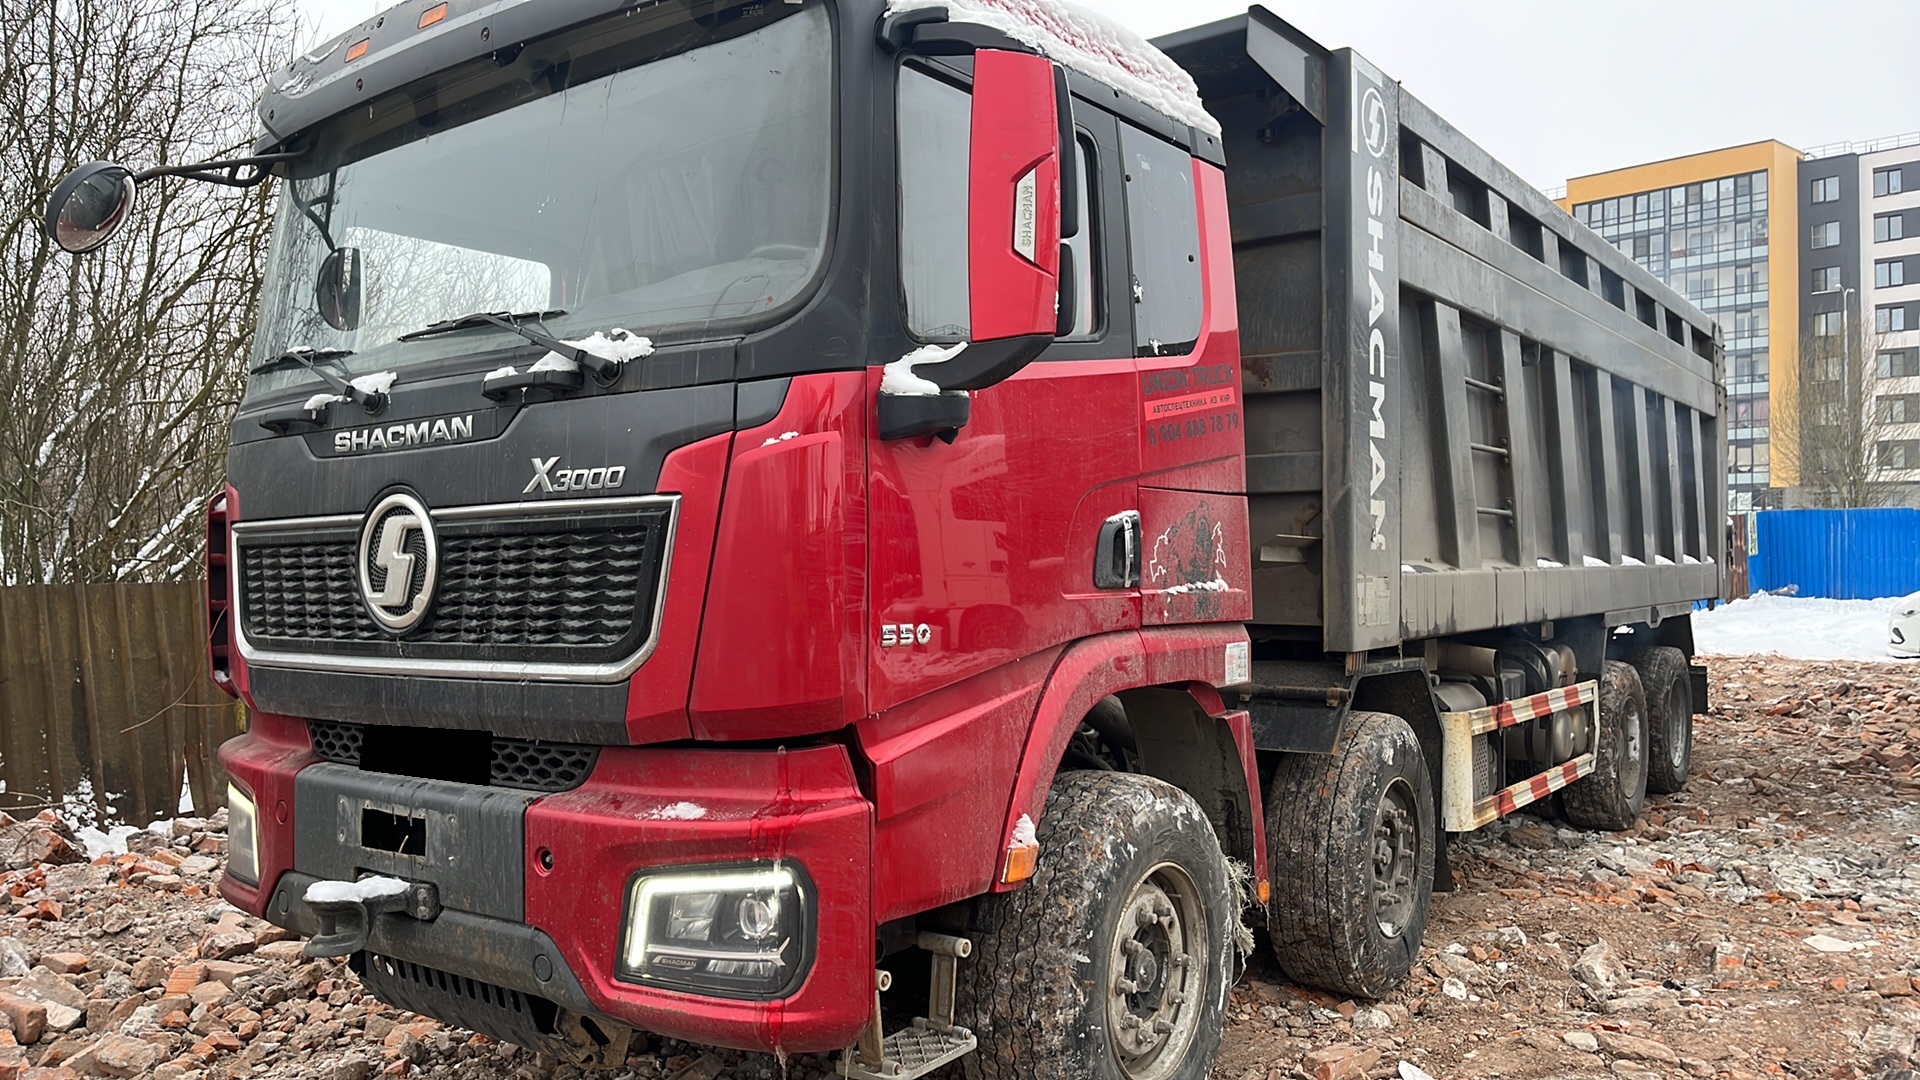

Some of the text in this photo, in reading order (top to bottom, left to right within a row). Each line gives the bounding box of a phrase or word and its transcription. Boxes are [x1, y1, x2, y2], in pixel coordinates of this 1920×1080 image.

[1022, 185, 1033, 247] SHACMAN
[1367, 166, 1386, 550] SHACMAN
[1142, 364, 1234, 395] UNION TRUCK
[1153, 394, 1231, 413] АВТОСПЕЦТЕХНИКА ИЗ КНР
[334, 415, 473, 452] SHACMAN
[1160, 423, 1182, 442] 904
[1186, 418, 1206, 438] 888
[1209, 415, 1223, 433] 78
[1226, 412, 1239, 430] 79
[522, 456, 626, 494] X3000
[881, 623, 931, 648] 550
[661, 958, 697, 967] SHACMAN
